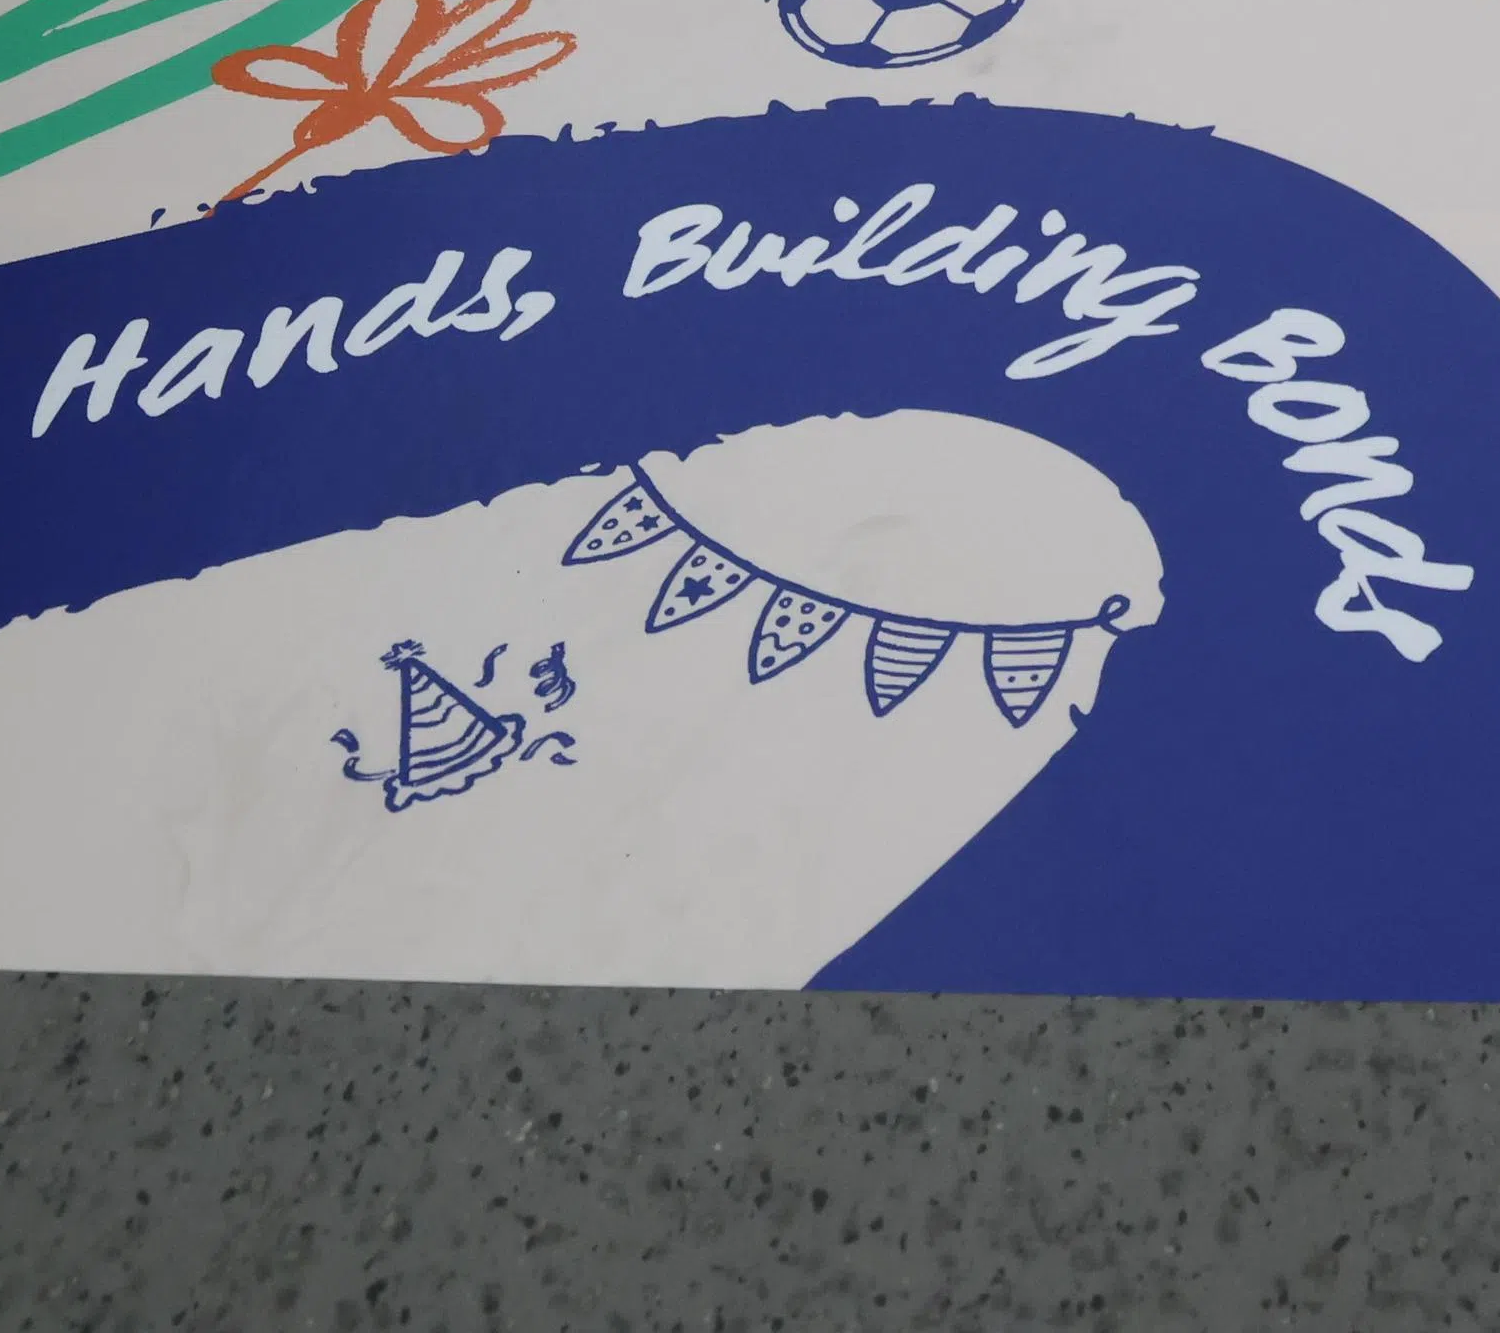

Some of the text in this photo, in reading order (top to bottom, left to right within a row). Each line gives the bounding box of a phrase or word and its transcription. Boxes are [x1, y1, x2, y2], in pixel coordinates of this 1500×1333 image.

[31, 246, 557, 437] Hands,
[622, 183, 1200, 380] Building
[1200, 308, 1474, 663] Bonds
